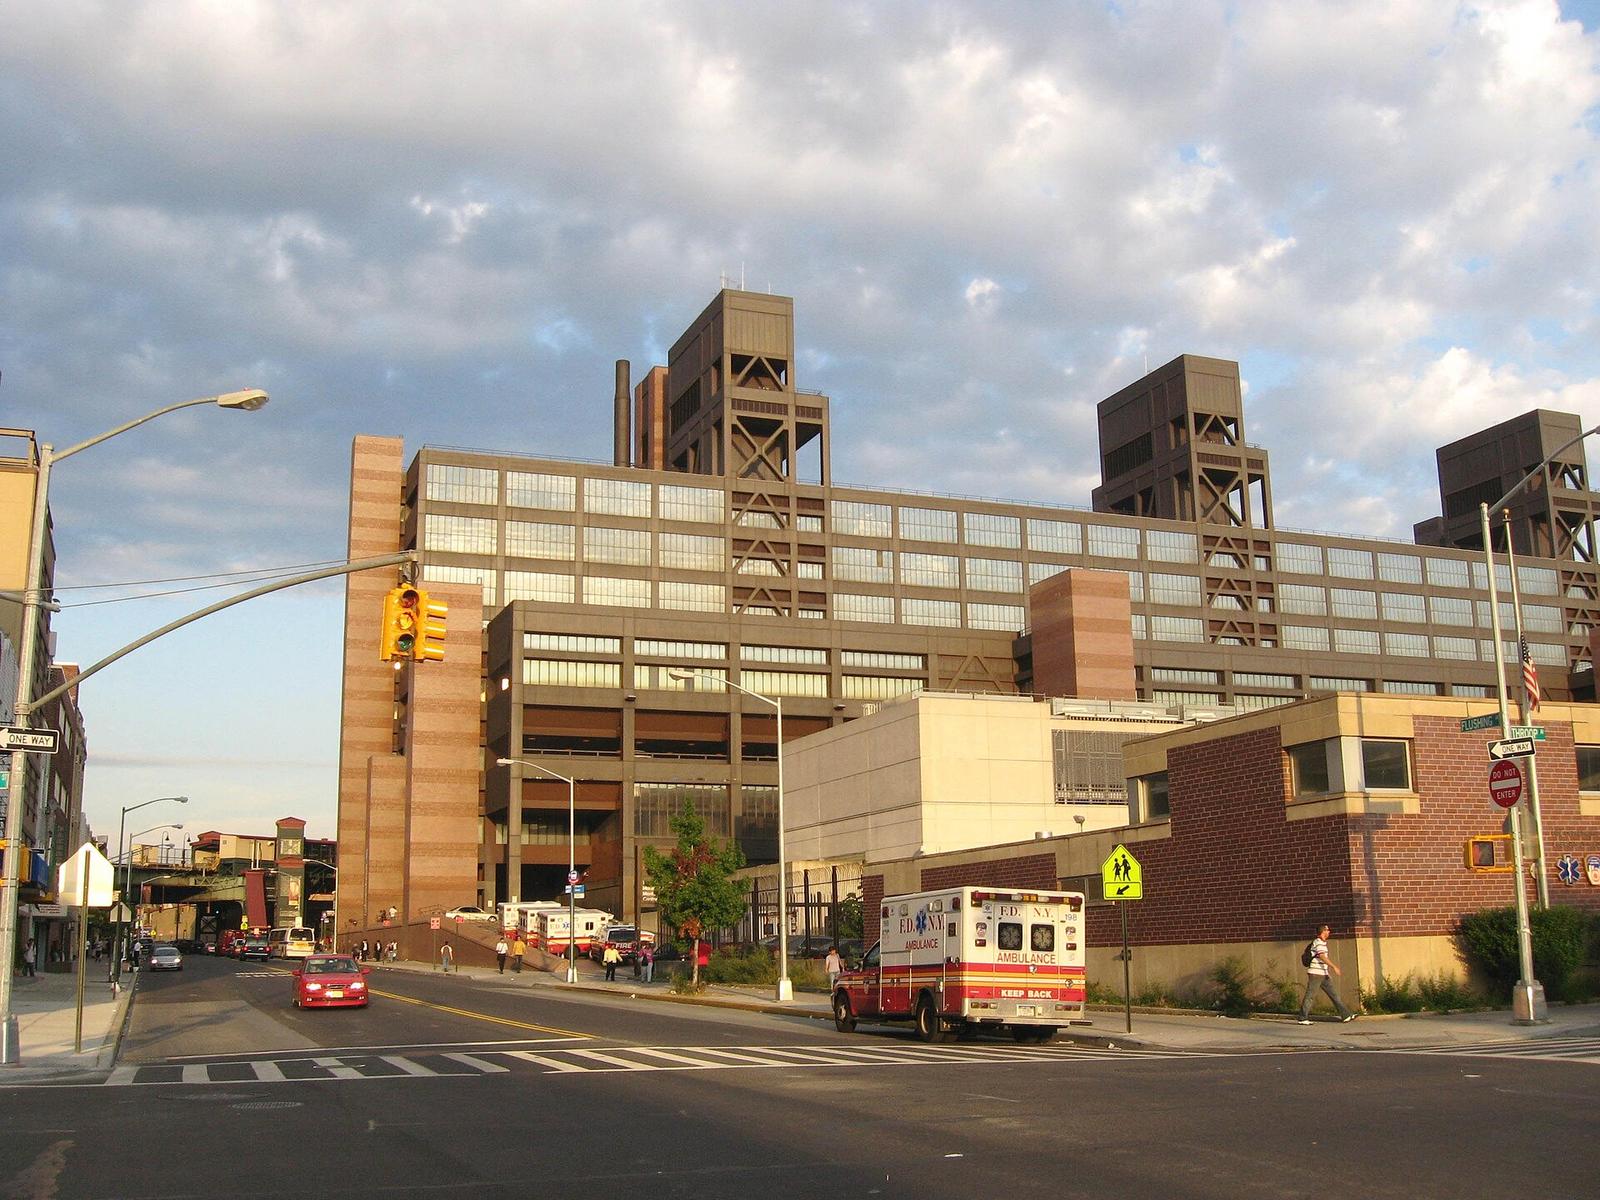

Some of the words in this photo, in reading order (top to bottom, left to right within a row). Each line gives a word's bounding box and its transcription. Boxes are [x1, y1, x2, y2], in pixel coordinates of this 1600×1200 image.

[1461, 715, 1493, 731] FLUSHING
[1511, 728, 1538, 739] THROOP
[9, 734, 28, 744] ONE
[31, 736, 51, 746] WAY
[1501, 745, 1516, 754] ONE
[1516, 742, 1530, 752] WAY
[1492, 770, 1502, 779] DO
[1503, 768, 1517, 777] NOT
[1496, 790, 1517, 800] ENTER
[1000, 905, 1021, 917] F.D.
[1033, 907, 1054, 918] N.Y.
[899, 918, 916, 934] F.D.
[904, 938, 939, 951] AMBULANCE
[996, 952, 1057, 965] AMBULANCE
[1001, 989, 1025, 998] KEEP
[1027, 990, 1053, 999] BACK
